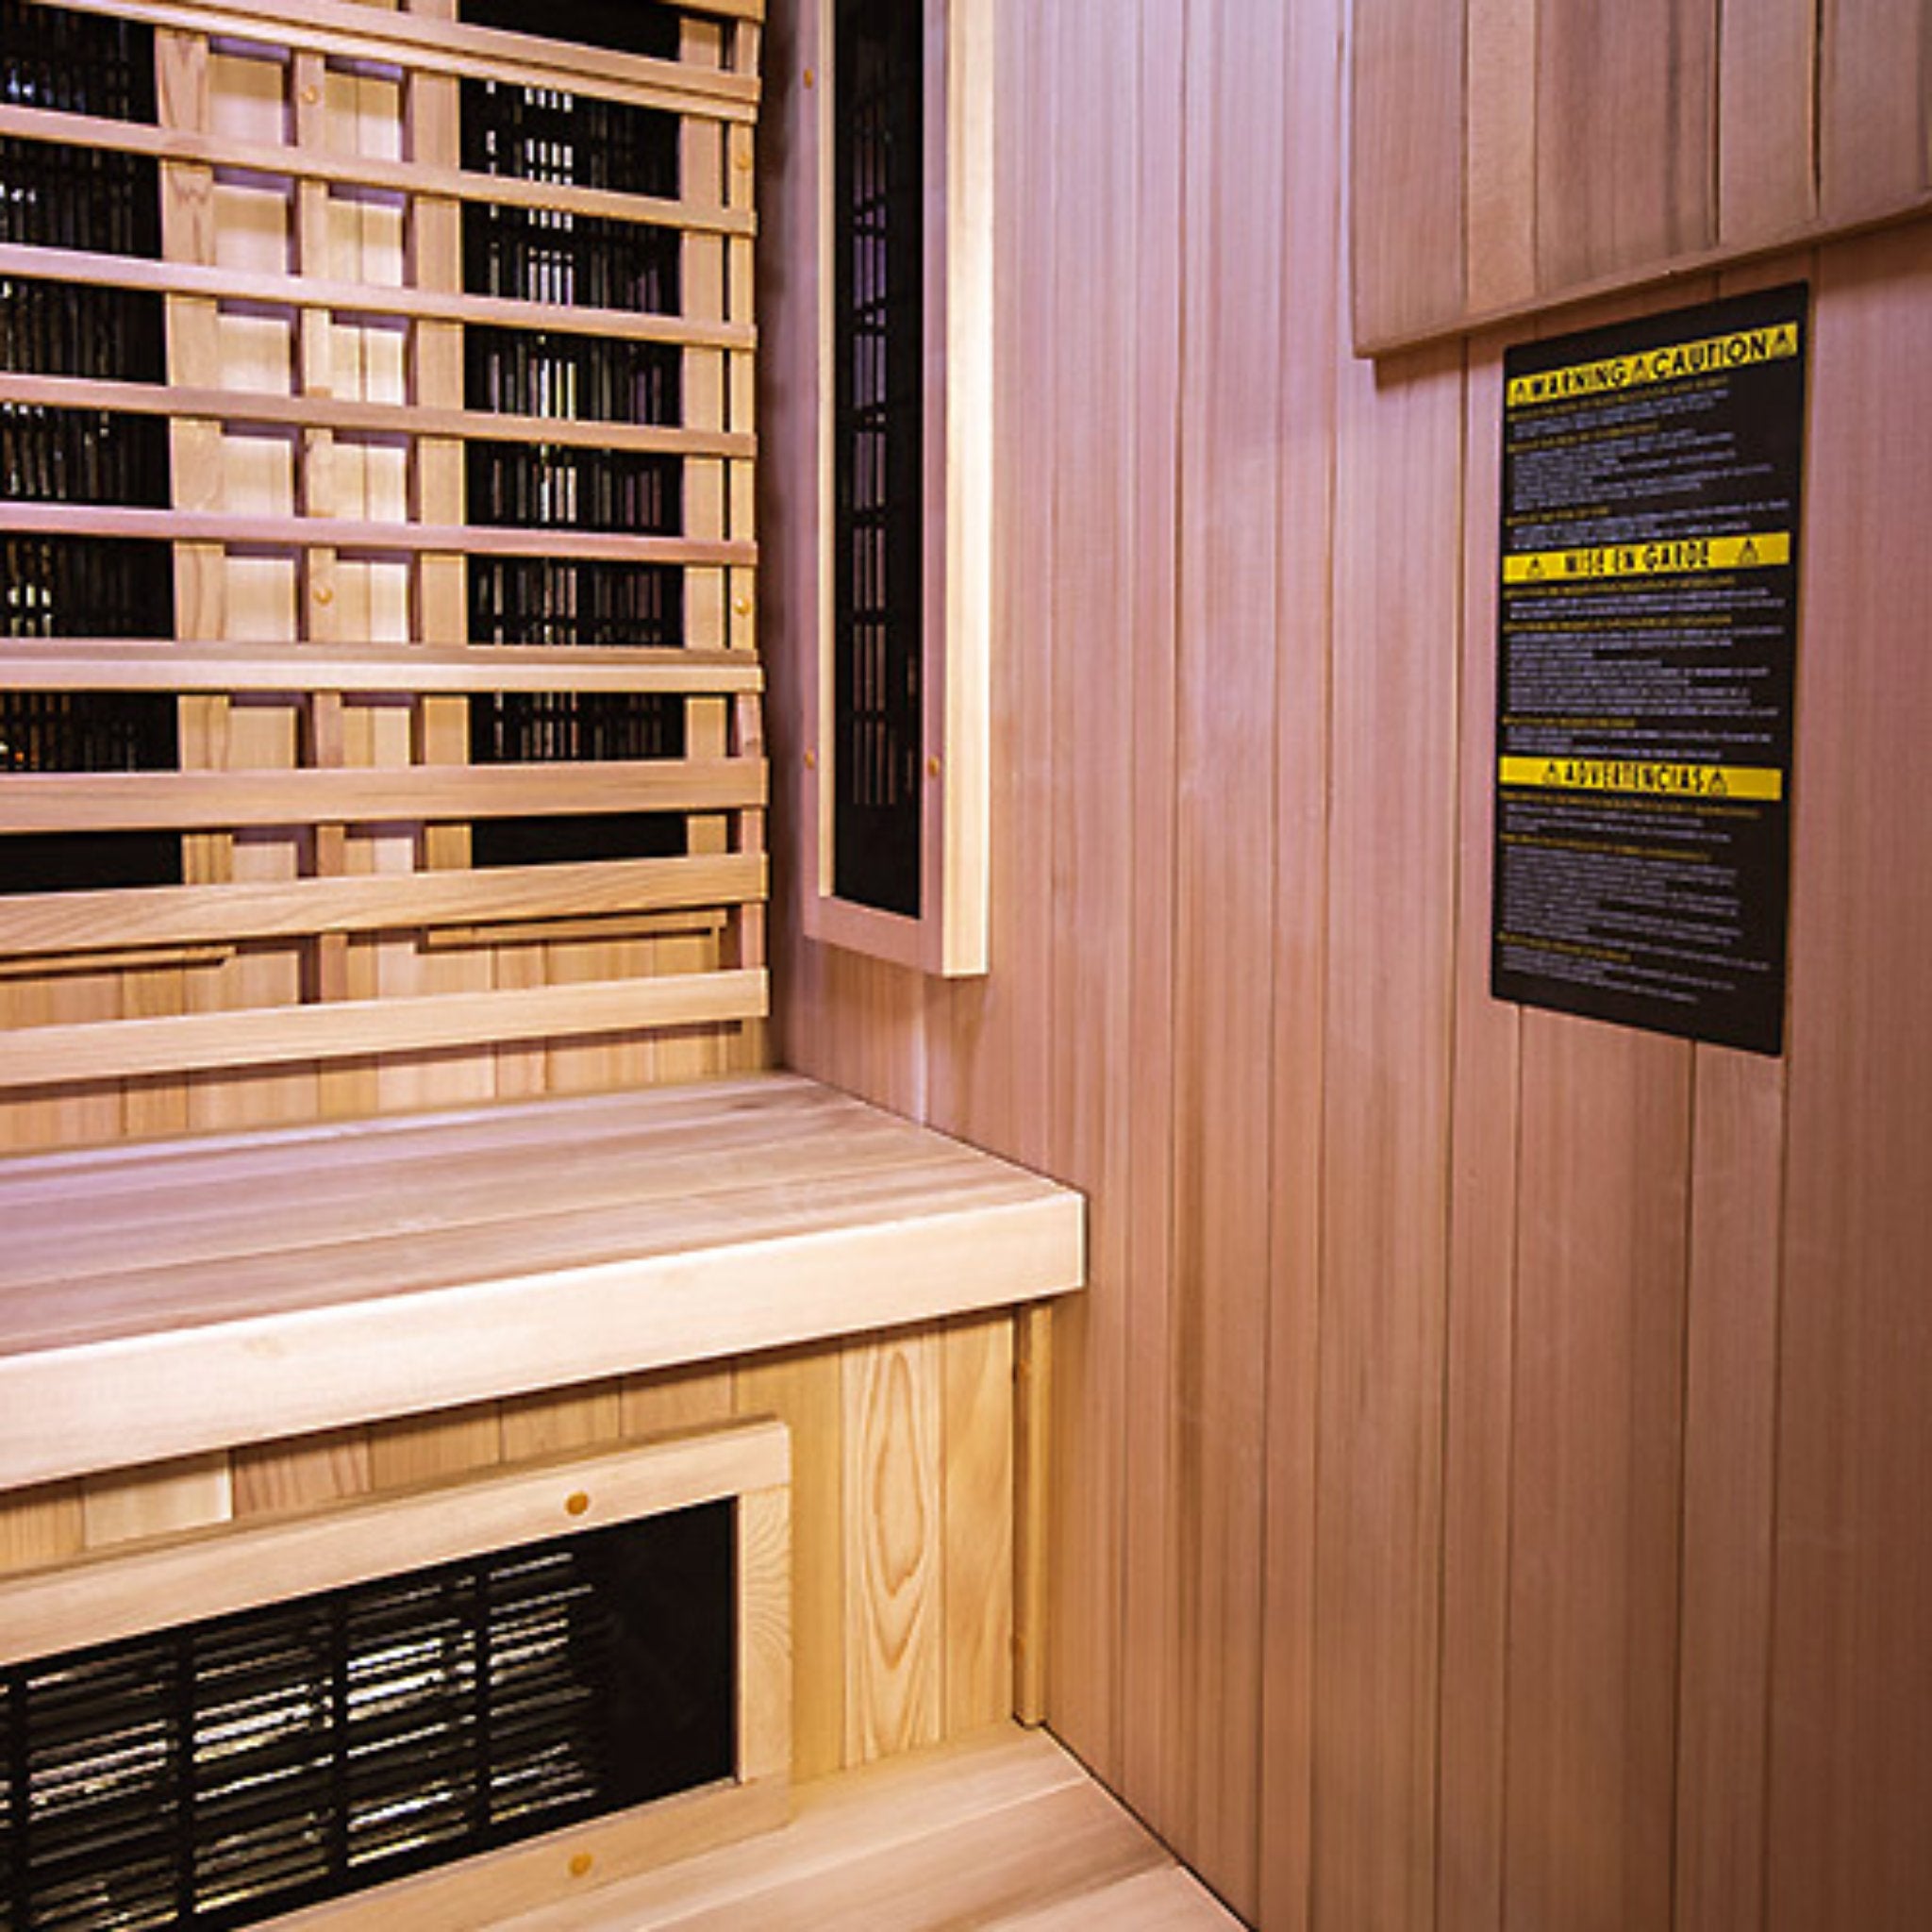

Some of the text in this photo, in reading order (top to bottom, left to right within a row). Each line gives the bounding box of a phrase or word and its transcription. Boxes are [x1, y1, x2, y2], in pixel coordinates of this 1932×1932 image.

[1532, 331, 1767, 396] WARNING CAUTION
[1564, 539, 1708, 576] MISE EN GARDE
[1564, 760, 1705, 792] ADVERTENCIAS
